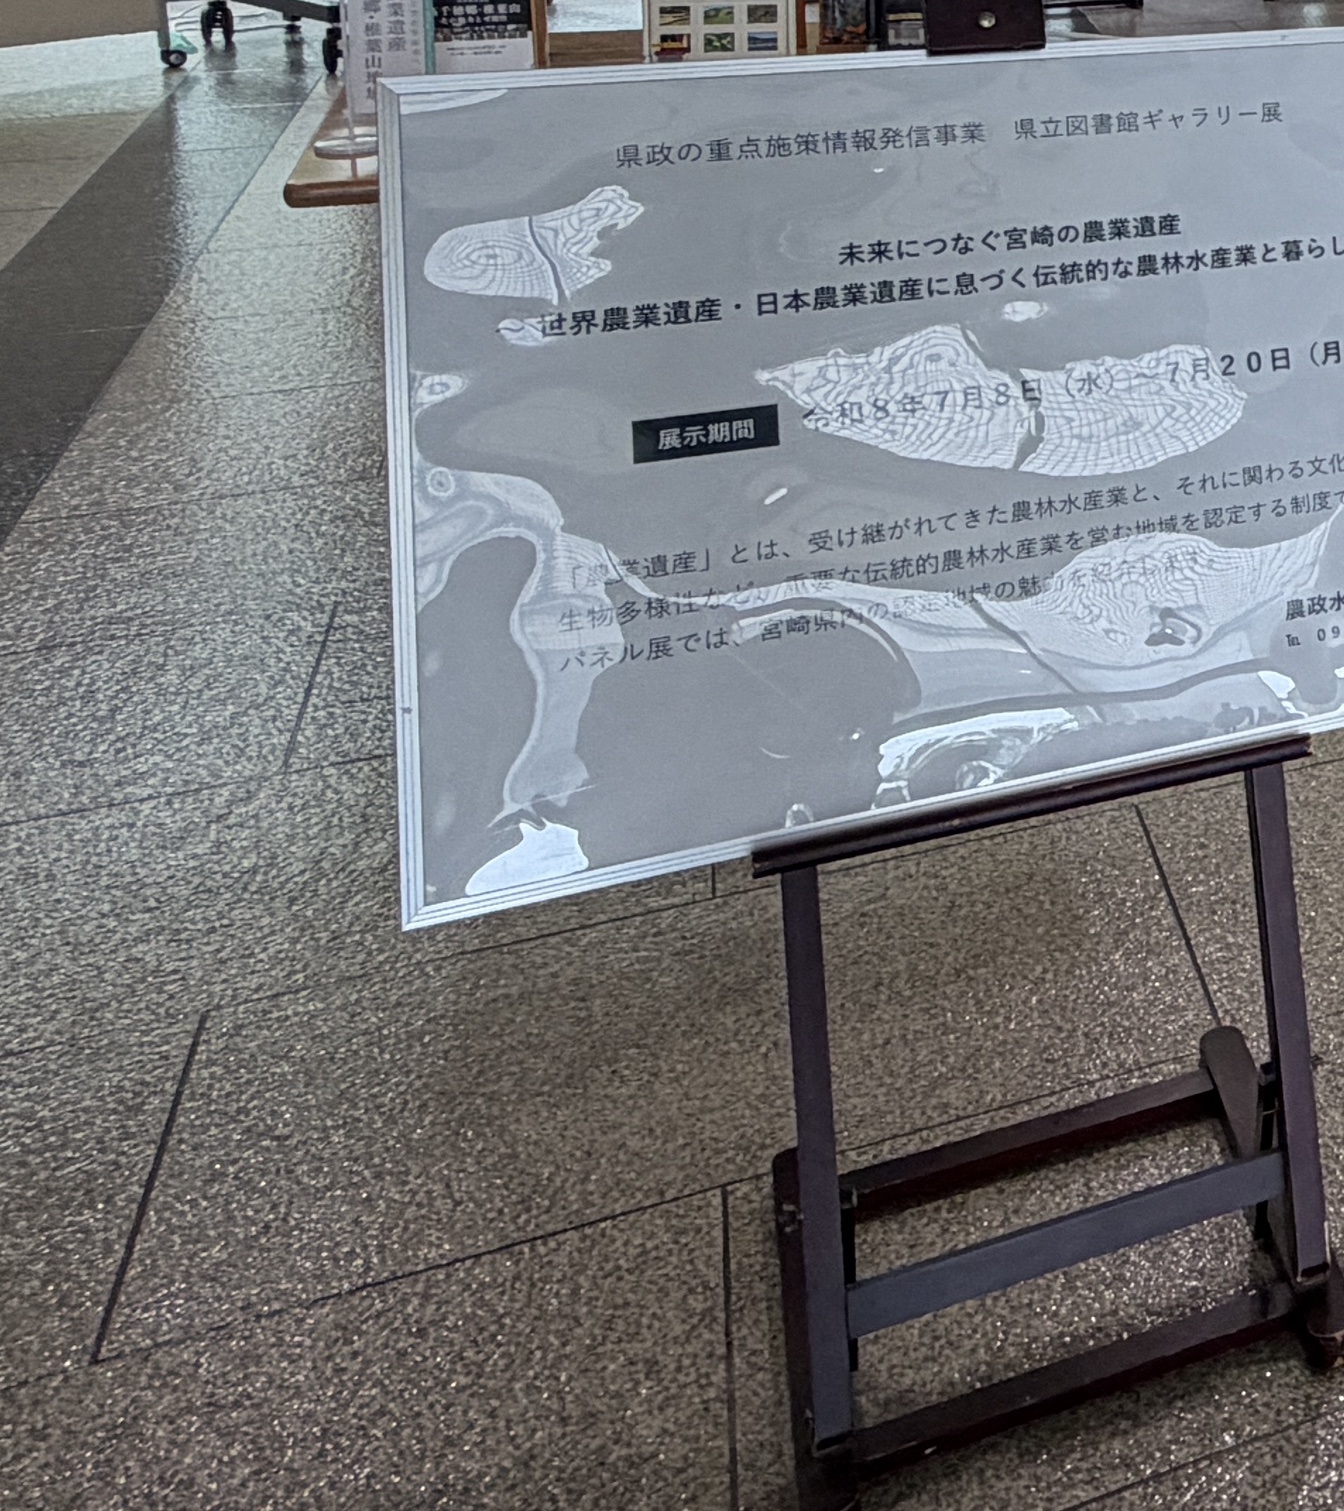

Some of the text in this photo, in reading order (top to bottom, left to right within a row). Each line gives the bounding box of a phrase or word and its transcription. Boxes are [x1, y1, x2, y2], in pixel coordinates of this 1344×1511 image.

[615, 102, 1284, 168] 県政の重点施策情報発信事業 県立図書館ギャラリー展
[837, 212, 1182, 267] 未来につなぐ宮崎の農業遺産
[657, 420, 756, 450] 展示期間
